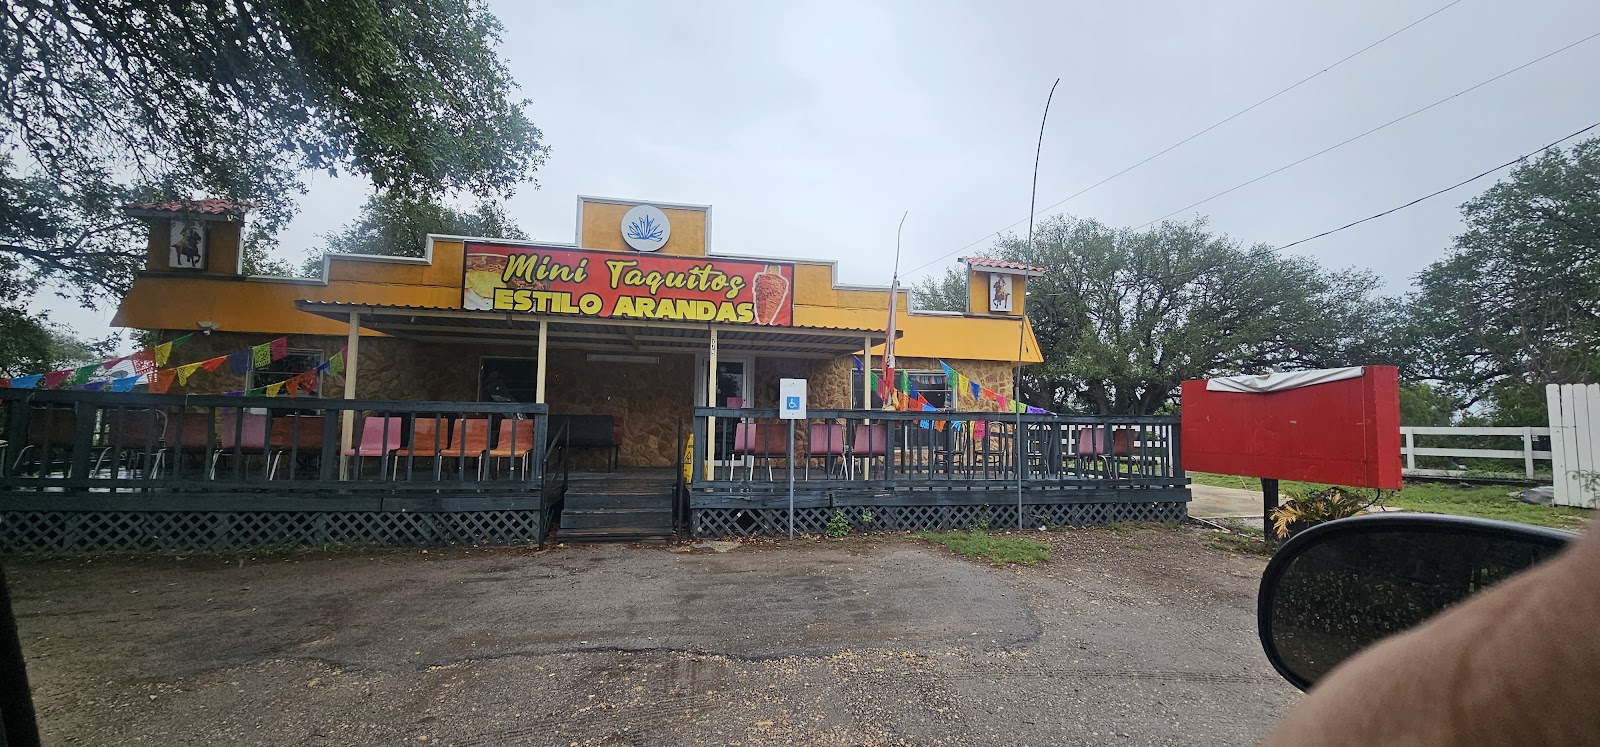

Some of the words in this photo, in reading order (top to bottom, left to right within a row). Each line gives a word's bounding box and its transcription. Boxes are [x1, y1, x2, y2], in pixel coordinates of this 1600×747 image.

[502, 253, 588, 283] Mini
[605, 259, 746, 299] Taquitos
[493, 288, 603, 315] ESTILO
[612, 295, 754, 323] ARANDAS
